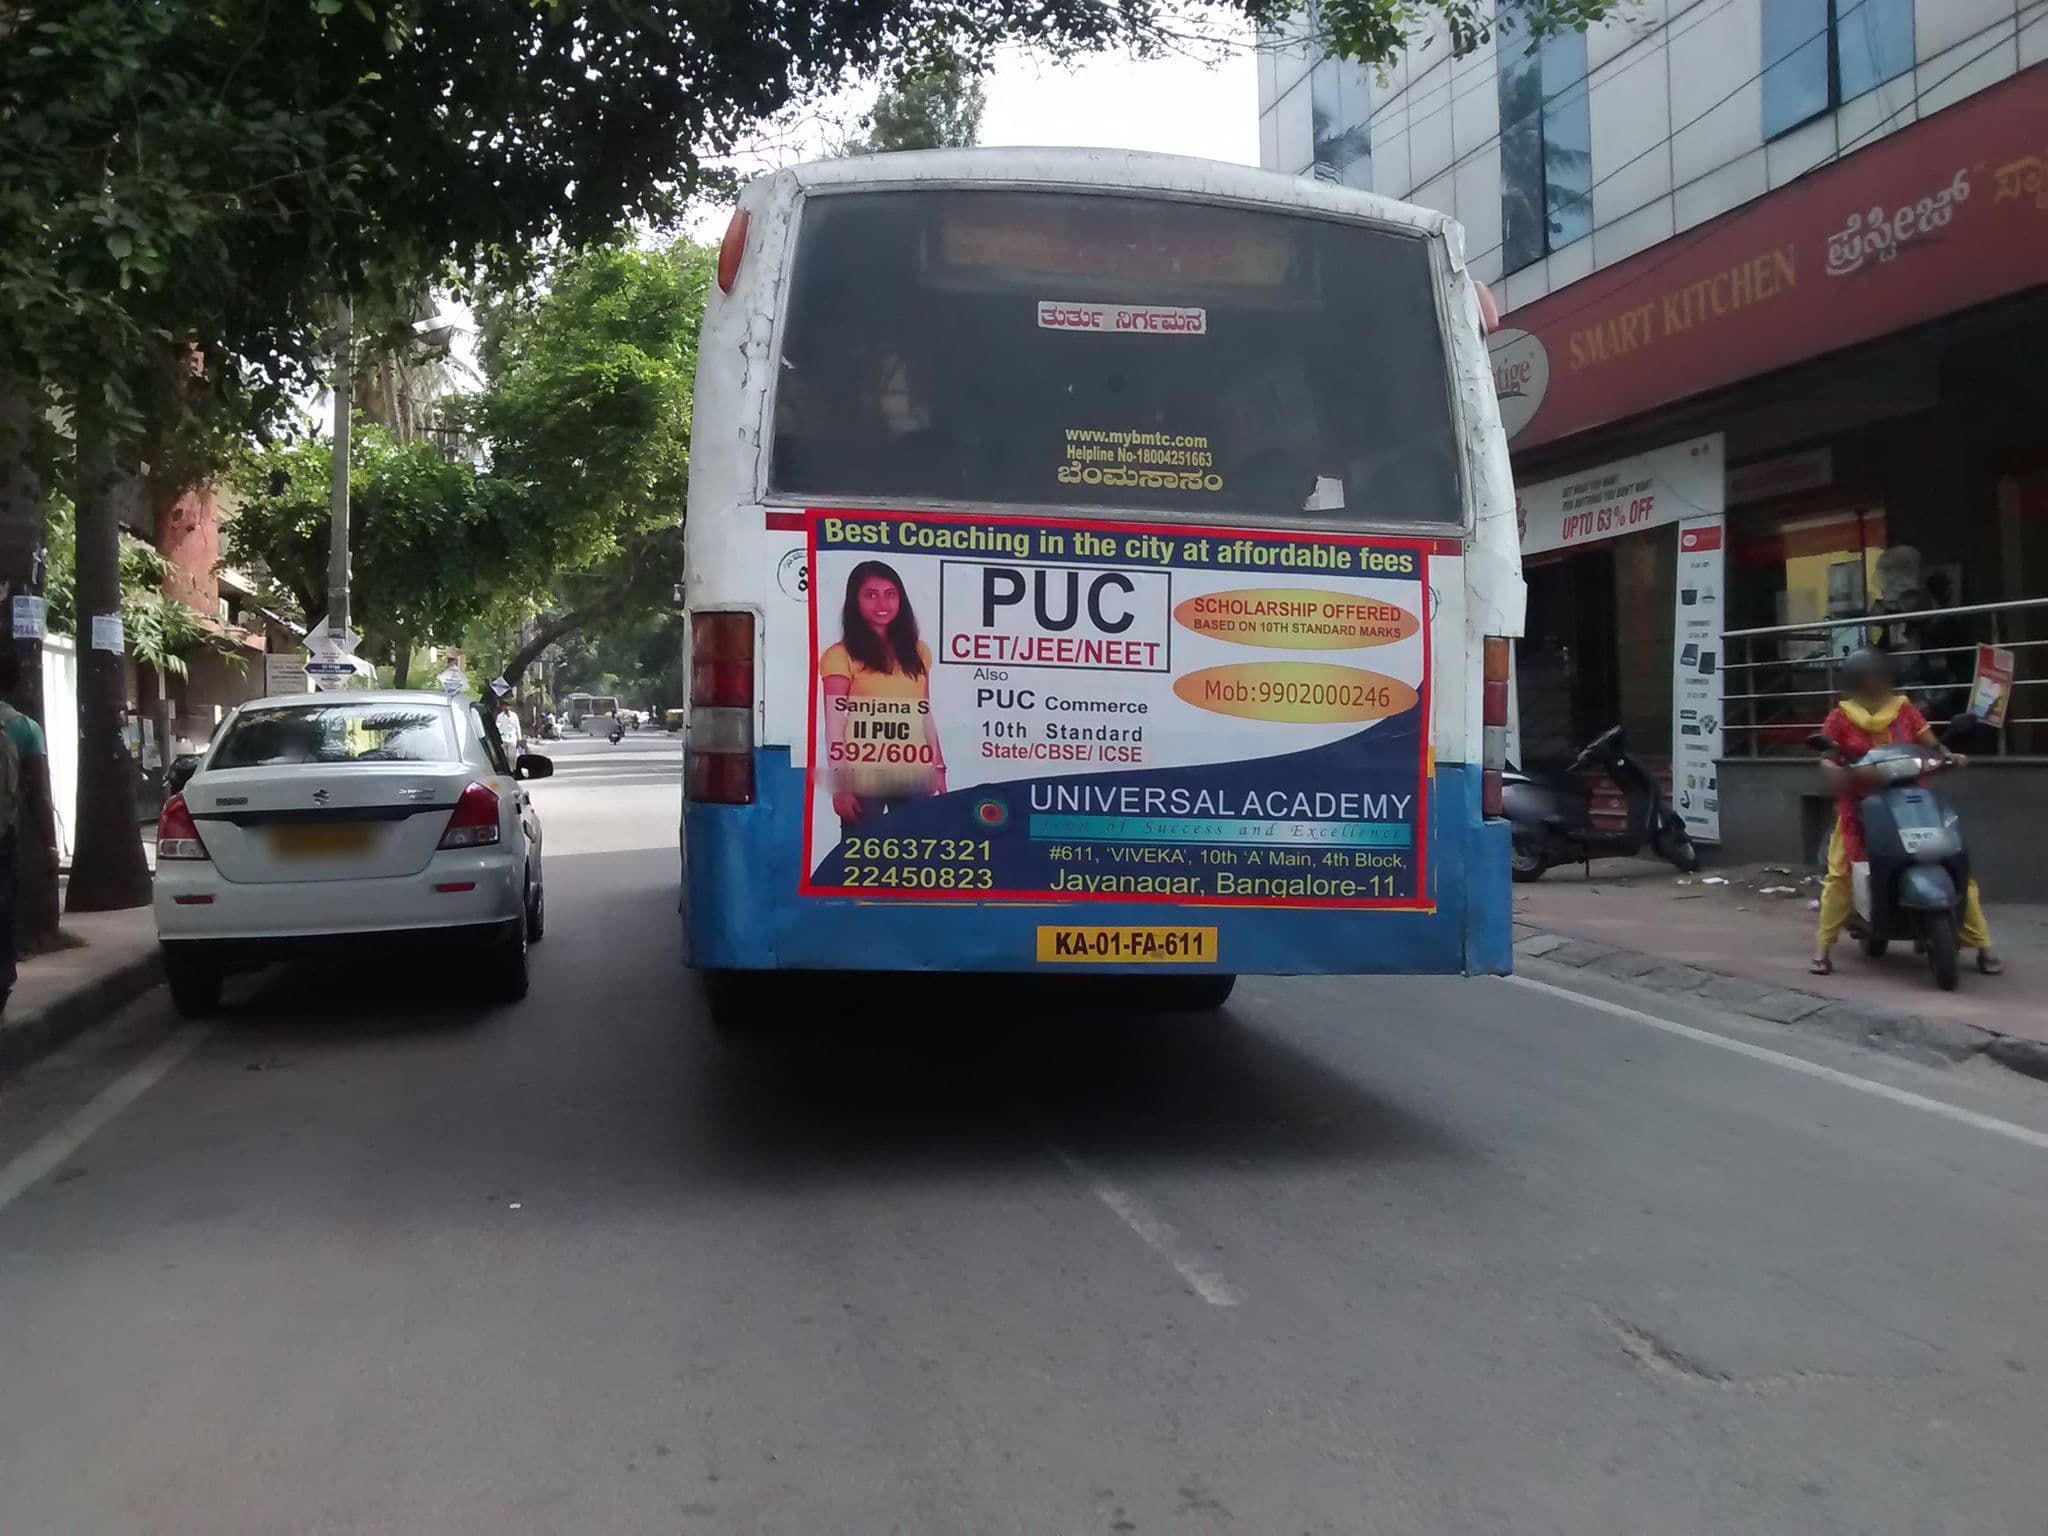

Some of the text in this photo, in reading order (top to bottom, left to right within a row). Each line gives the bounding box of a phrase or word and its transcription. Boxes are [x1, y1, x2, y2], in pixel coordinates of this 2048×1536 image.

[1570, 243, 1797, 371] SMART KITCHEN
[1116, 310, 1202, 331] ನಿರ್ಗಮನ
[1065, 428, 1208, 448] www.mybmtc.com
[1066, 444, 1114, 463] Helpline
[1562, 512, 1594, 540] UPTO
[1629, 496, 1655, 525] OFF
[824, 517, 1413, 573] Best Coaching in the city at affordable fees
[982, 567, 1135, 634] PUC
[1194, 598, 1401, 622] SCHOLARSHIP OFFERED
[1194, 619, 1401, 639] BASED ON 10TH STANDARD MARKS
[951, 633, 1161, 666] CET/JEE/NEET
[973, 667, 1009, 682] Also
[976, 688, 1148, 714] PUC Commerce
[1205, 679, 1390, 708] Mob:9902000246
[834, 697, 930, 716] Sanjana S
[853, 721, 910, 740] II PUC
[981, 720, 1143, 742] 10th Standard
[829, 741, 934, 764] 592/600
[981, 741, 1143, 763] State/CBSE/ ICSE
[1030, 784, 1411, 820] UNIVERSAL ACADEMY
[1143, 820, 1223, 835] Success
[1238, 823, 1278, 836] and
[843, 837, 991, 861] 26637321
[1049, 846, 1100, 864] #611,
[1200, 849, 1238, 865] 10th
[1269, 852, 1316, 868] Main,
[1322, 852, 1350, 867] 4th
[1355, 853, 1407, 869] Block,
[842, 866, 993, 889] 22450823
[1050, 868, 1405, 898] Jayanagar, Bangalore-11.
[1055, 931, 1203, 956] KA-01-FA-611
